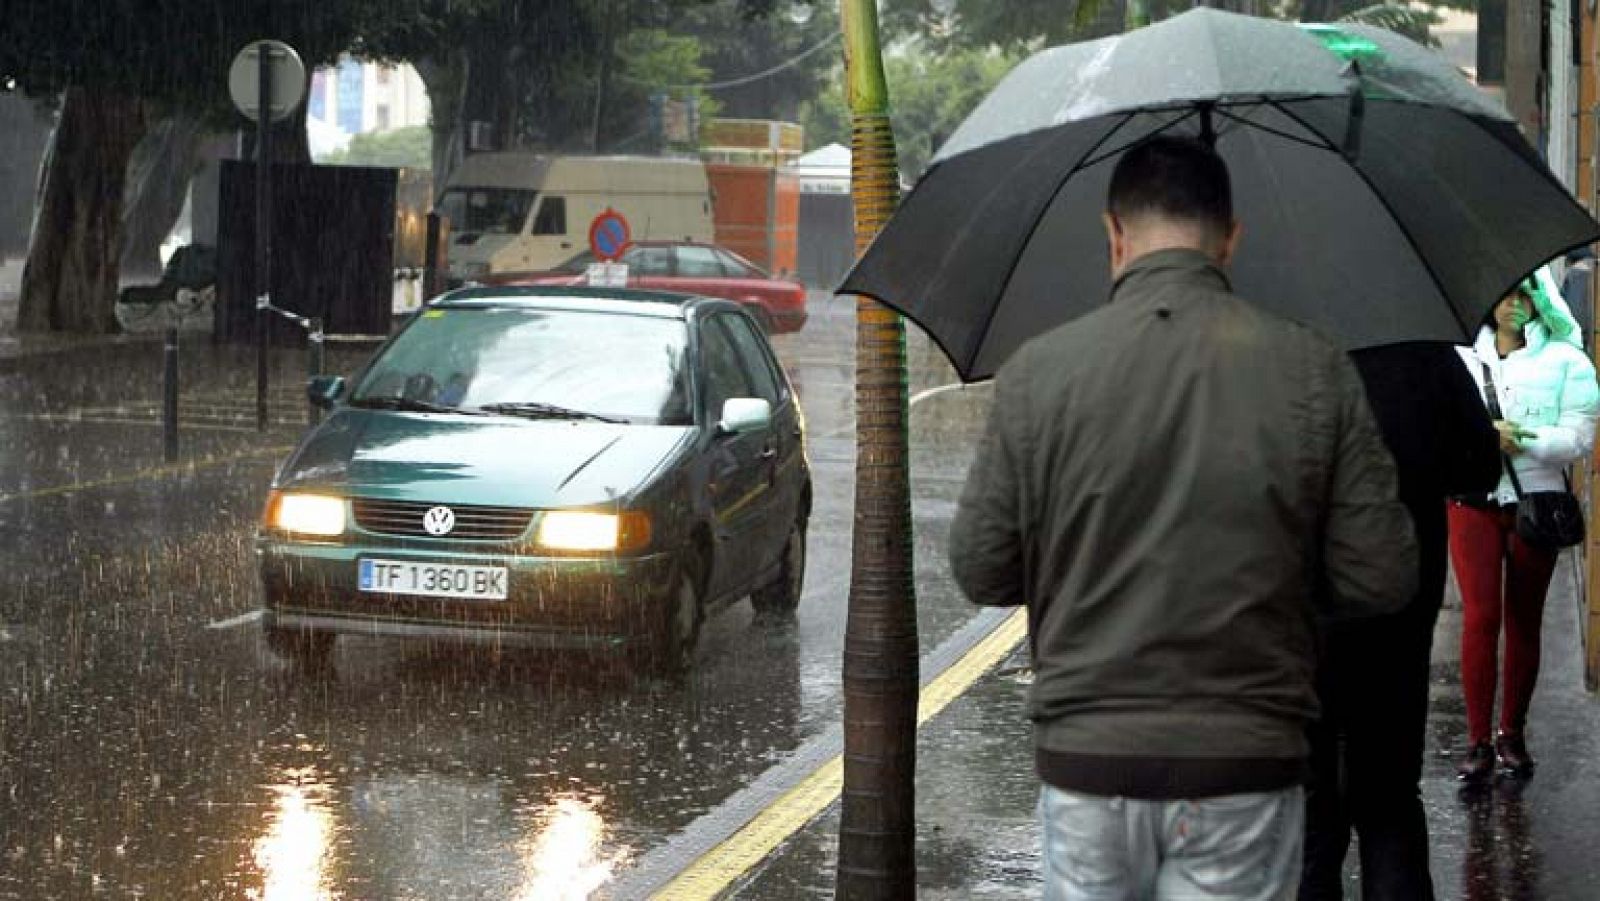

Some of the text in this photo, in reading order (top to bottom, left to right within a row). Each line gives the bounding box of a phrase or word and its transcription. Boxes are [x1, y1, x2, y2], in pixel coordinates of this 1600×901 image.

[375, 564, 402, 588] TF
[411, 566, 469, 592] 1360
[474, 570, 503, 595] BK
